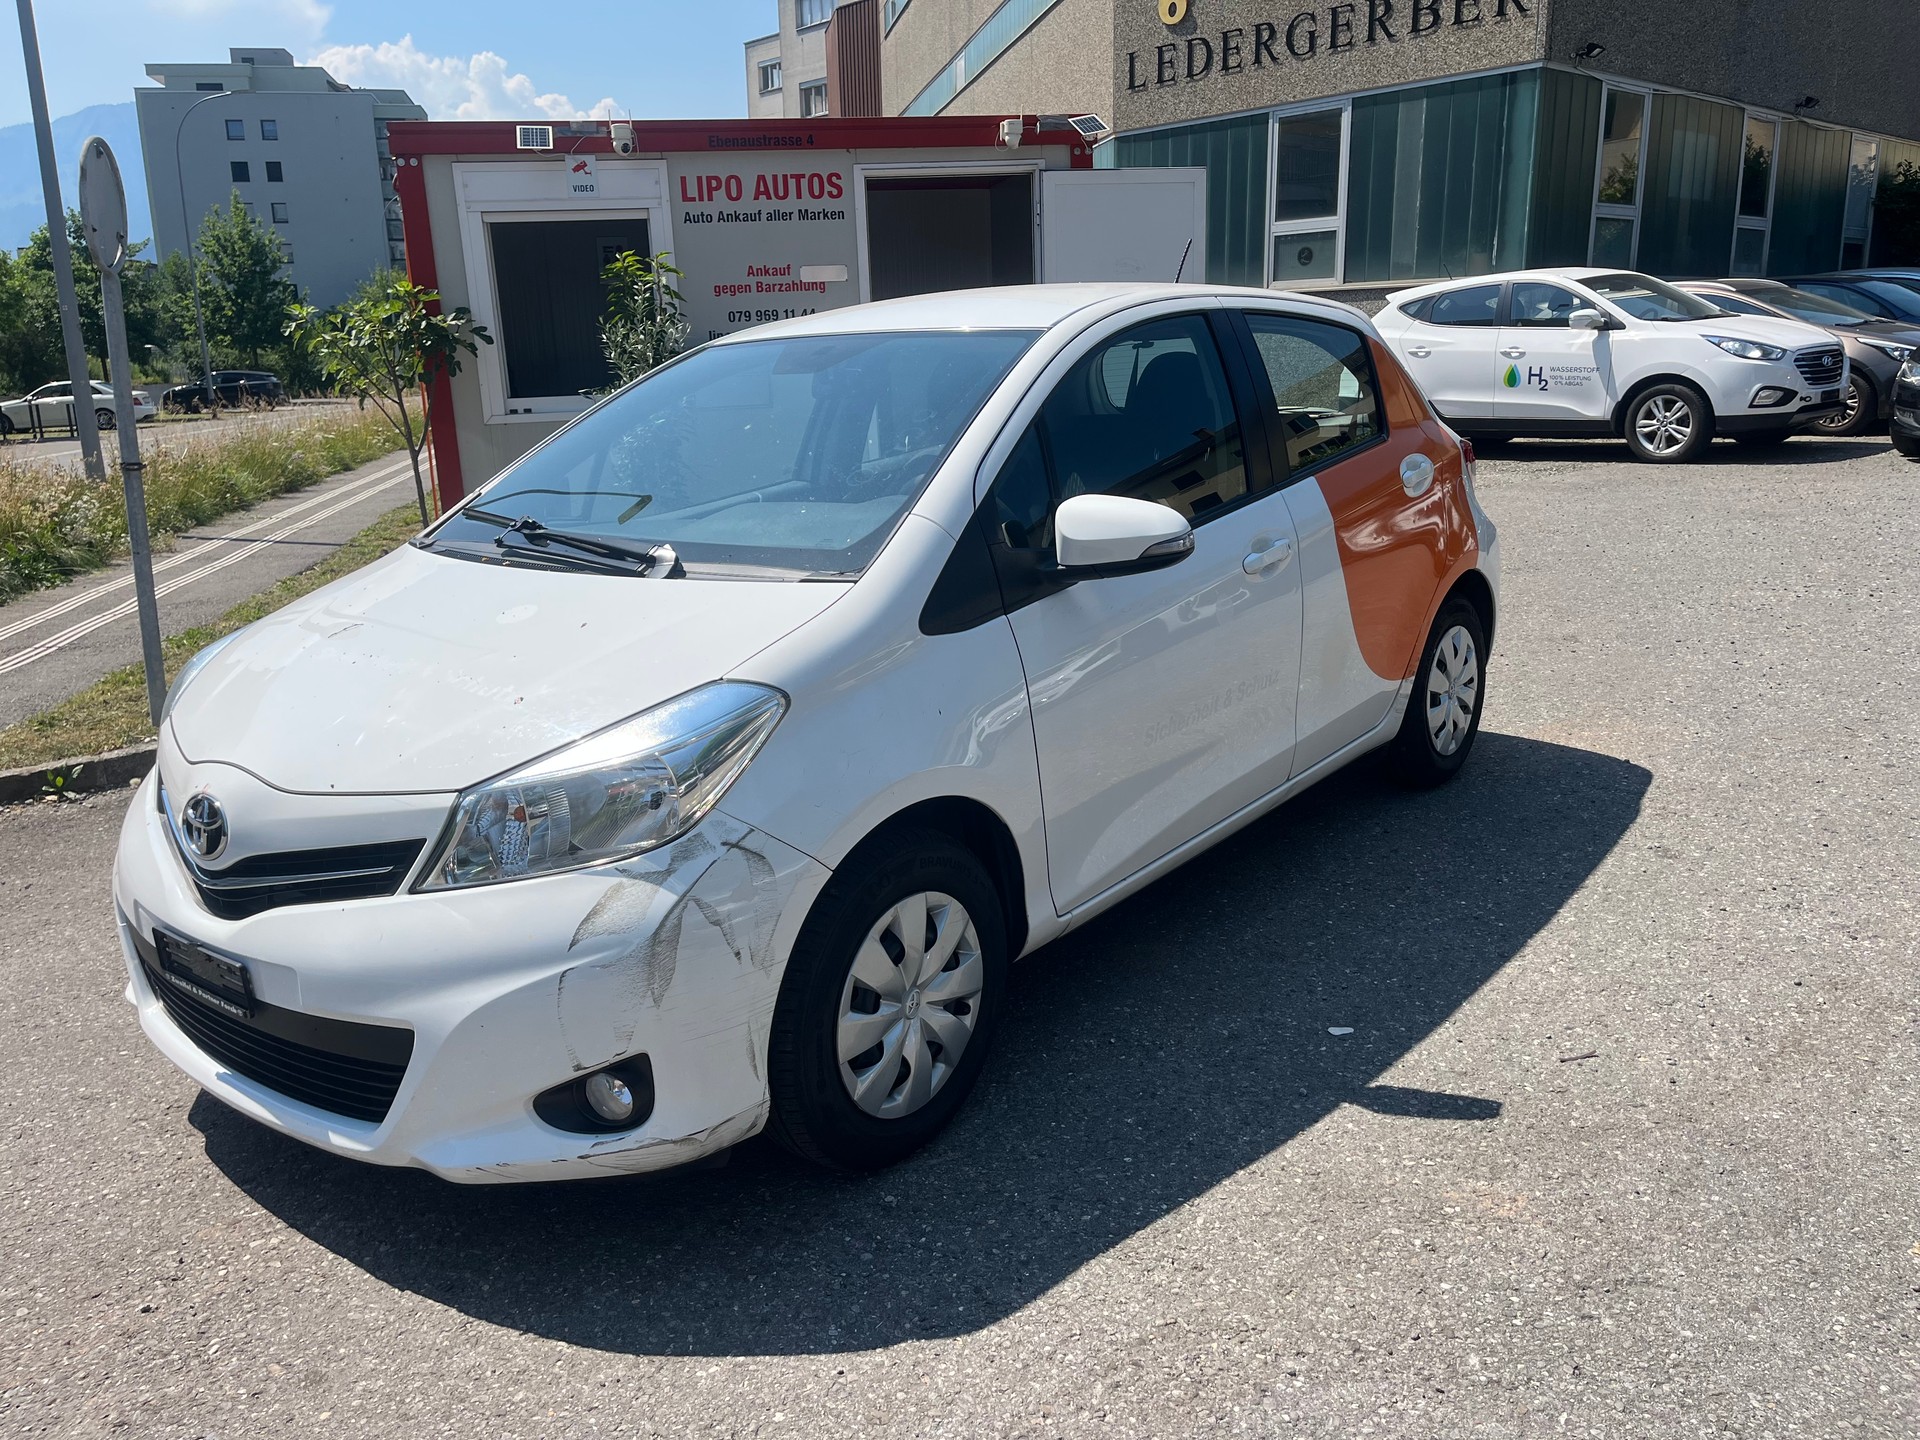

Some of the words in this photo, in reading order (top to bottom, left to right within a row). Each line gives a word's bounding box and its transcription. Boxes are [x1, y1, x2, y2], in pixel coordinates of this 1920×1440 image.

[708, 134, 803, 148] Ebenaustrasse
[806, 133, 815, 146] 4
[572, 184, 595, 193] VIDEO
[680, 174, 743, 203] LIPO
[753, 172, 844, 201] AUTOS
[683, 211, 713, 224] Auto
[717, 209, 762, 223] Ankauf
[766, 209, 794, 222] aller
[798, 208, 845, 221] Marken
[747, 263, 792, 277] Ankauf
[713, 284, 752, 297] gegen
[755, 280, 826, 294] Barzahlung
[728, 310, 751, 323] 079
[756, 309, 779, 322] 969
[783, 308, 795, 319] 11
[1549, 366, 1600, 374] WASSERSTOFF
